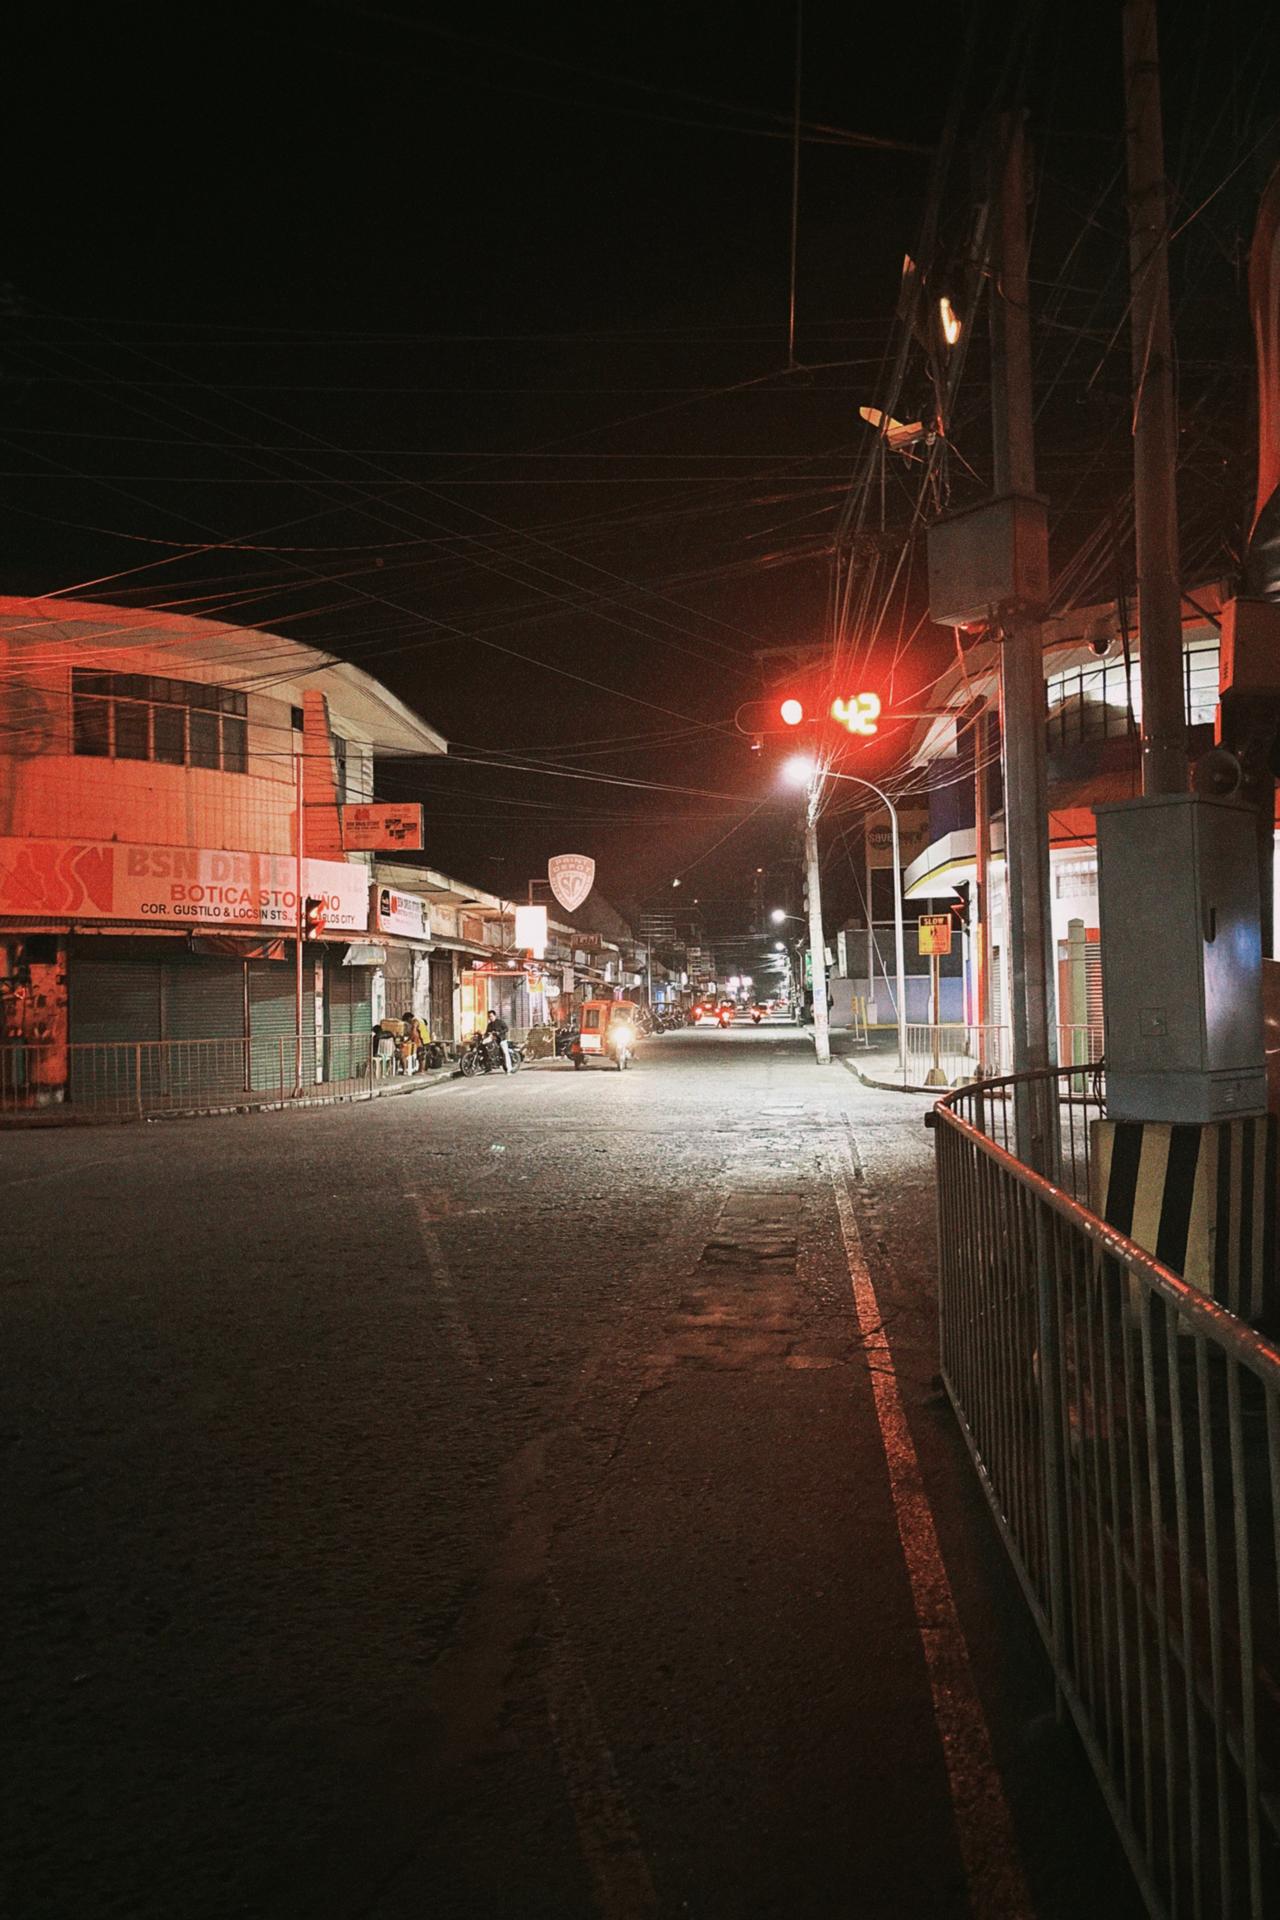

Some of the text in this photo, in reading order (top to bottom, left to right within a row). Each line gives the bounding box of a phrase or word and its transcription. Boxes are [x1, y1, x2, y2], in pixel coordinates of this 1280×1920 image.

[832, 692, 880, 735] 42
[127, 848, 198, 880] BSN
[170, 884, 252, 905] BOTICA
[141, 903, 170, 915] COR.
[173, 904, 221, 918] GUSTILO
[223, 906, 231, 918] &
[233, 907, 267, 920] LOCSIN
[341, 914, 355, 924] CITY
[923, 917, 945, 925] SLOW
